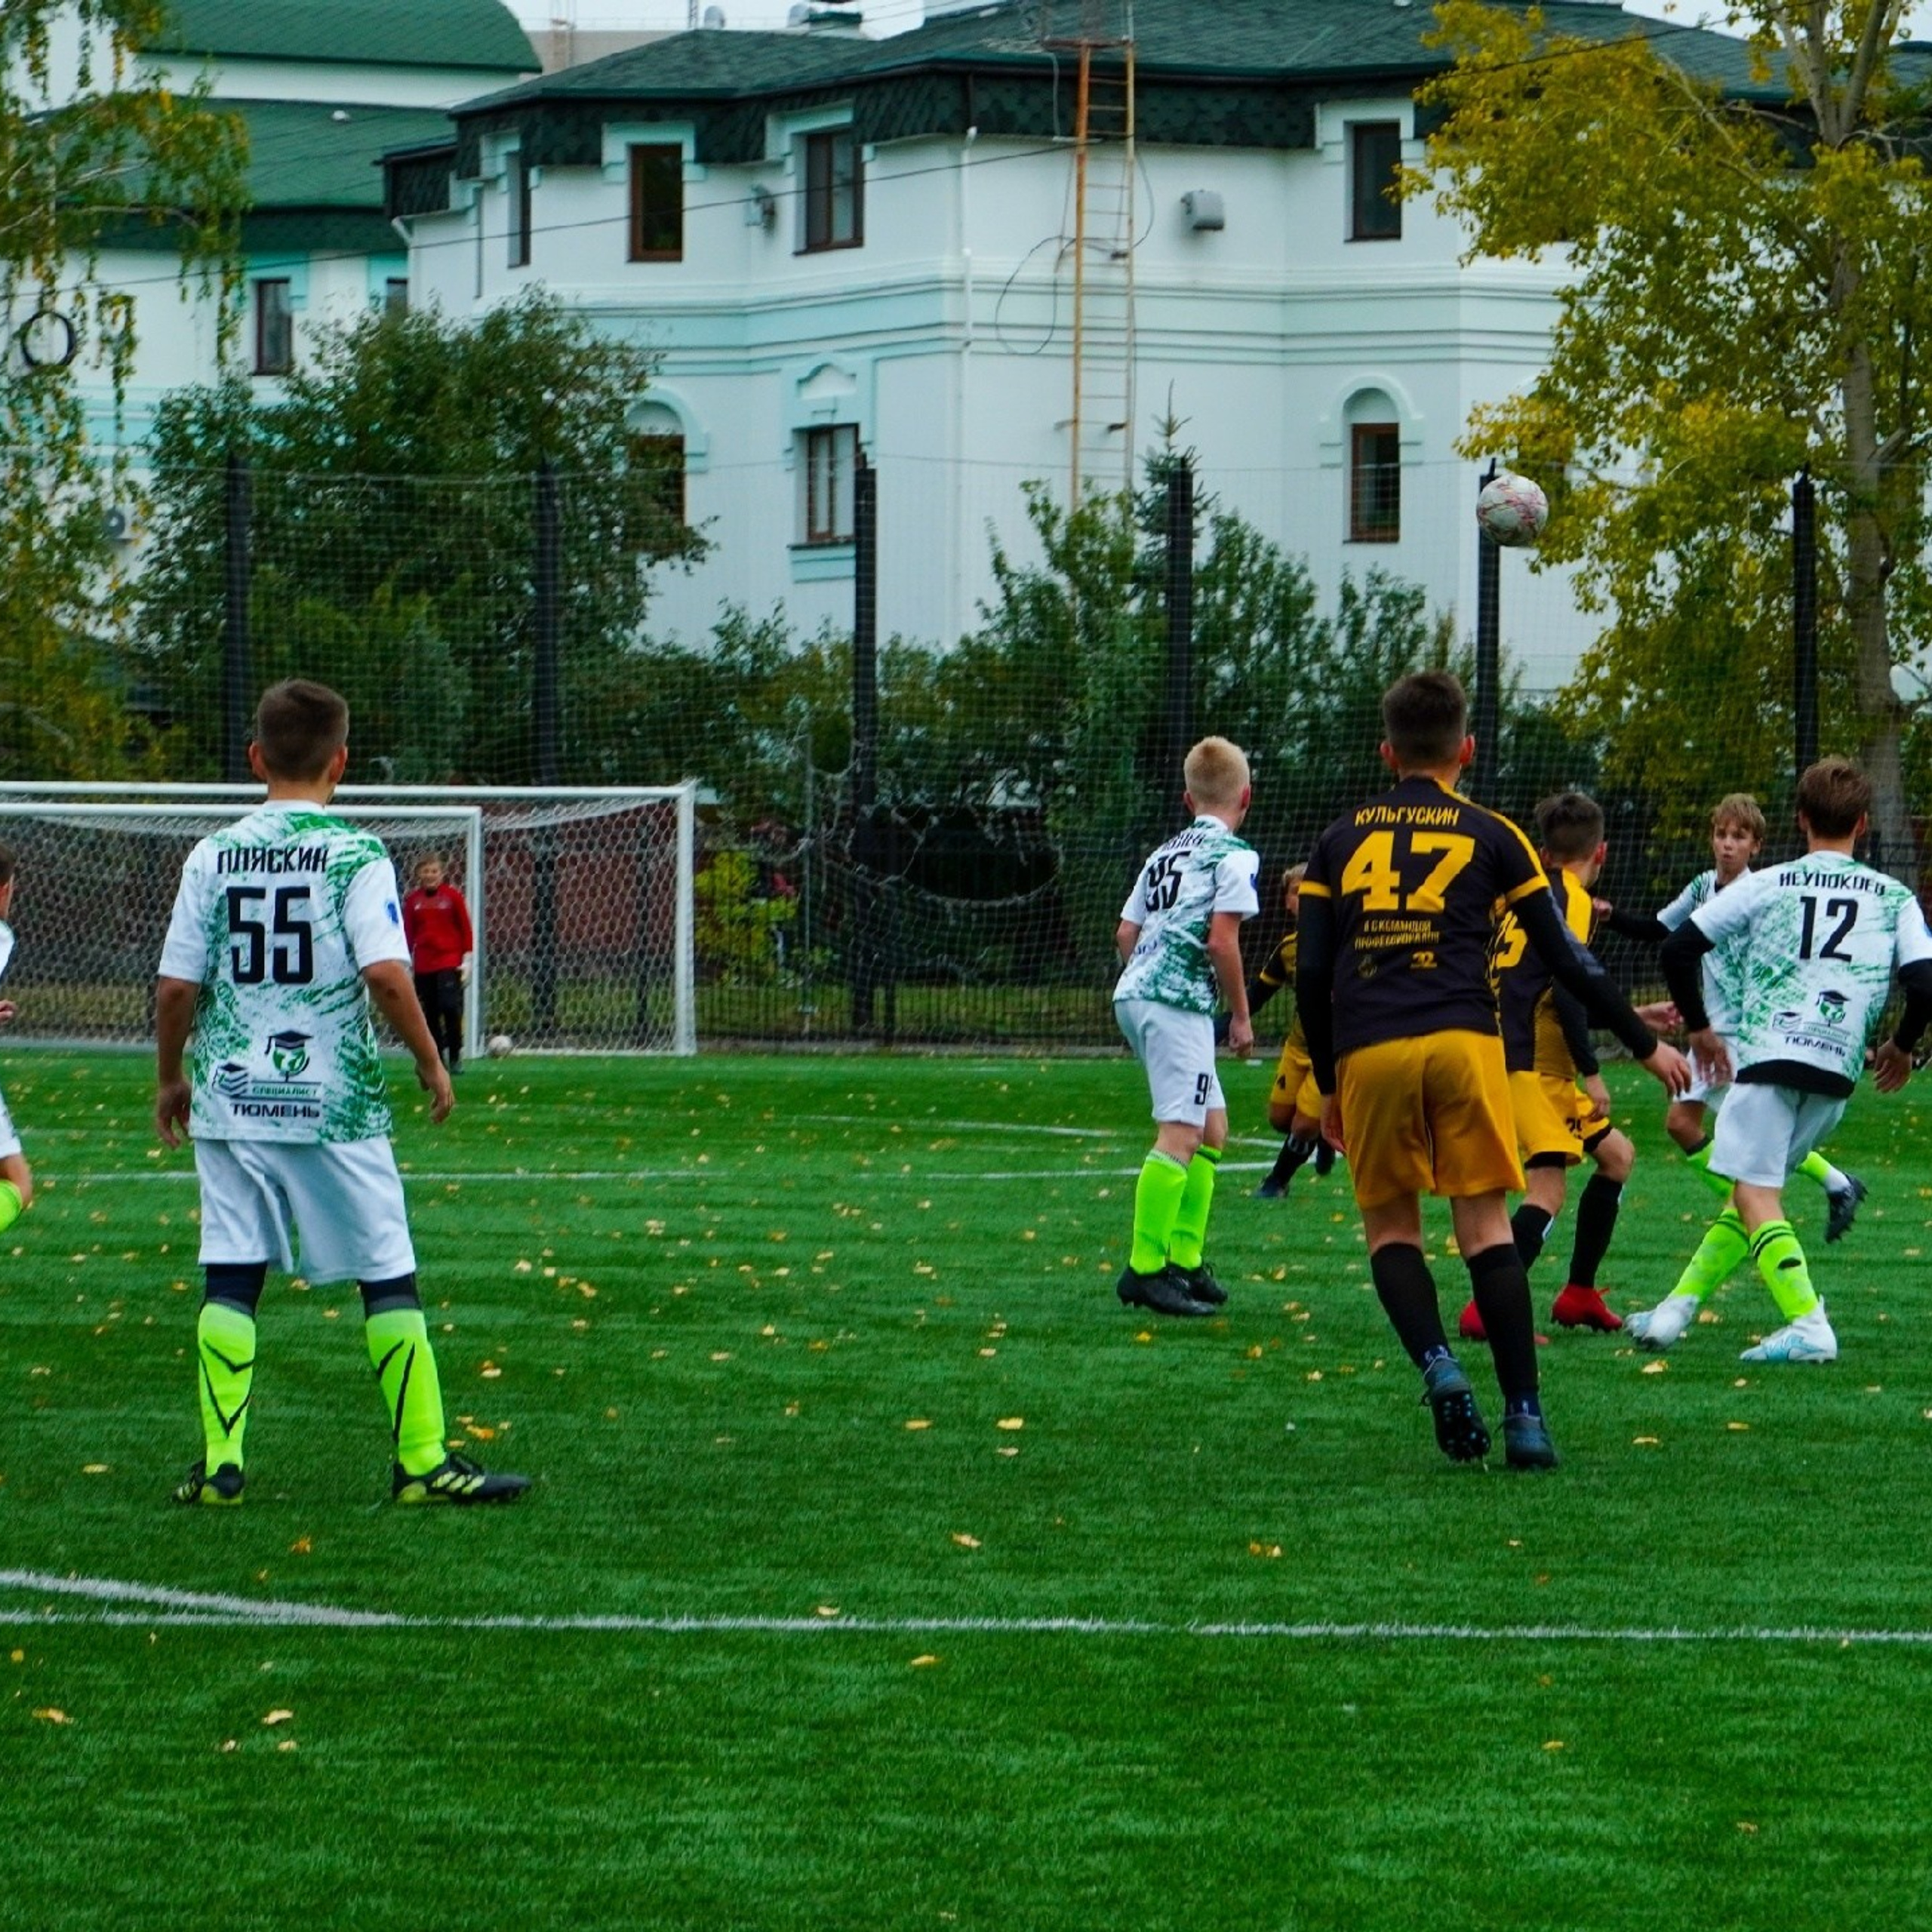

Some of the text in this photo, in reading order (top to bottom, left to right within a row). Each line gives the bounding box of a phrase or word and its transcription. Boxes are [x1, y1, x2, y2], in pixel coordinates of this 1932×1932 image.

[1355, 805, 1460, 827] КУЛЬГУСКИН
[217, 846, 328, 875] ПЛЯСКИН
[1341, 829, 1475, 913] 47
[226, 885, 313, 984] 55
[1799, 896, 1859, 963] 12
[229, 1103, 321, 1118] ТЮМЕНЬ
